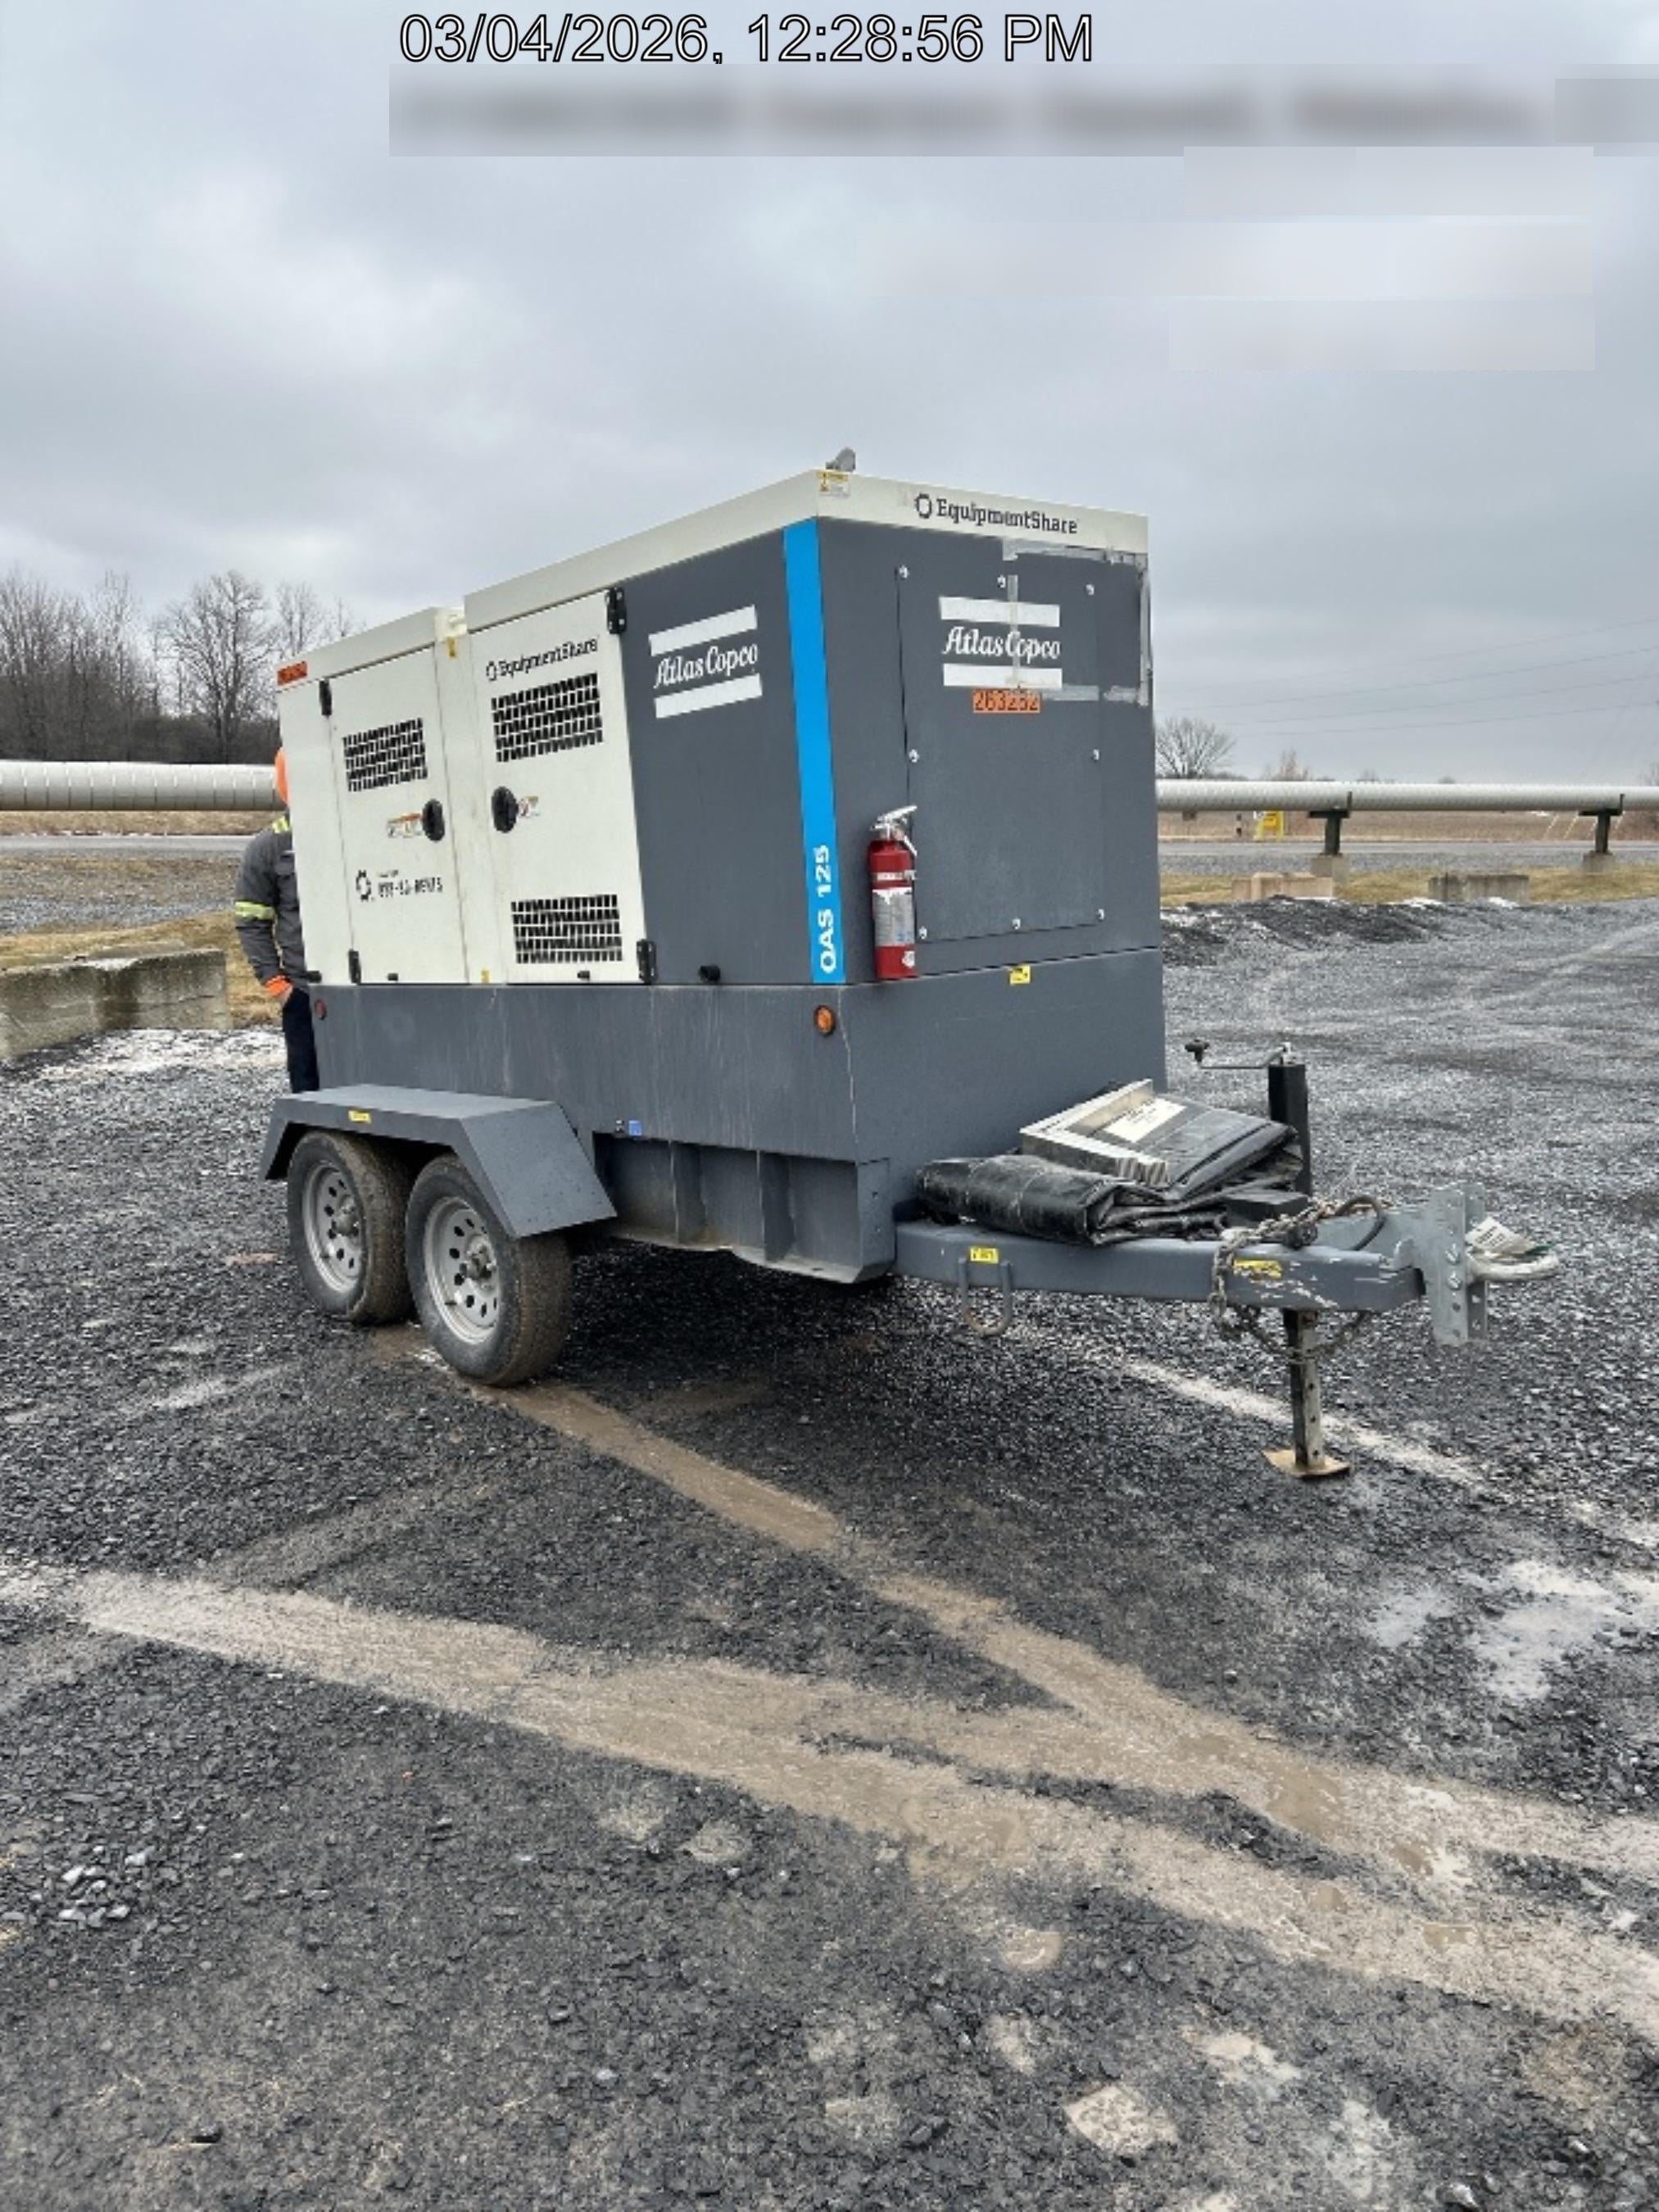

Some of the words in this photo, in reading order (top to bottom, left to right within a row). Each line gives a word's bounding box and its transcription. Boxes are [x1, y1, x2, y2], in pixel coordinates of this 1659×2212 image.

[936, 498, 1077, 534] EquipmentShare
[653, 655, 704, 689] Atlas
[705, 643, 758, 677] Copco
[941, 626, 1004, 657] Atlas
[1004, 630, 1061, 664] Copco
[813, 845, 832, 897] 125
